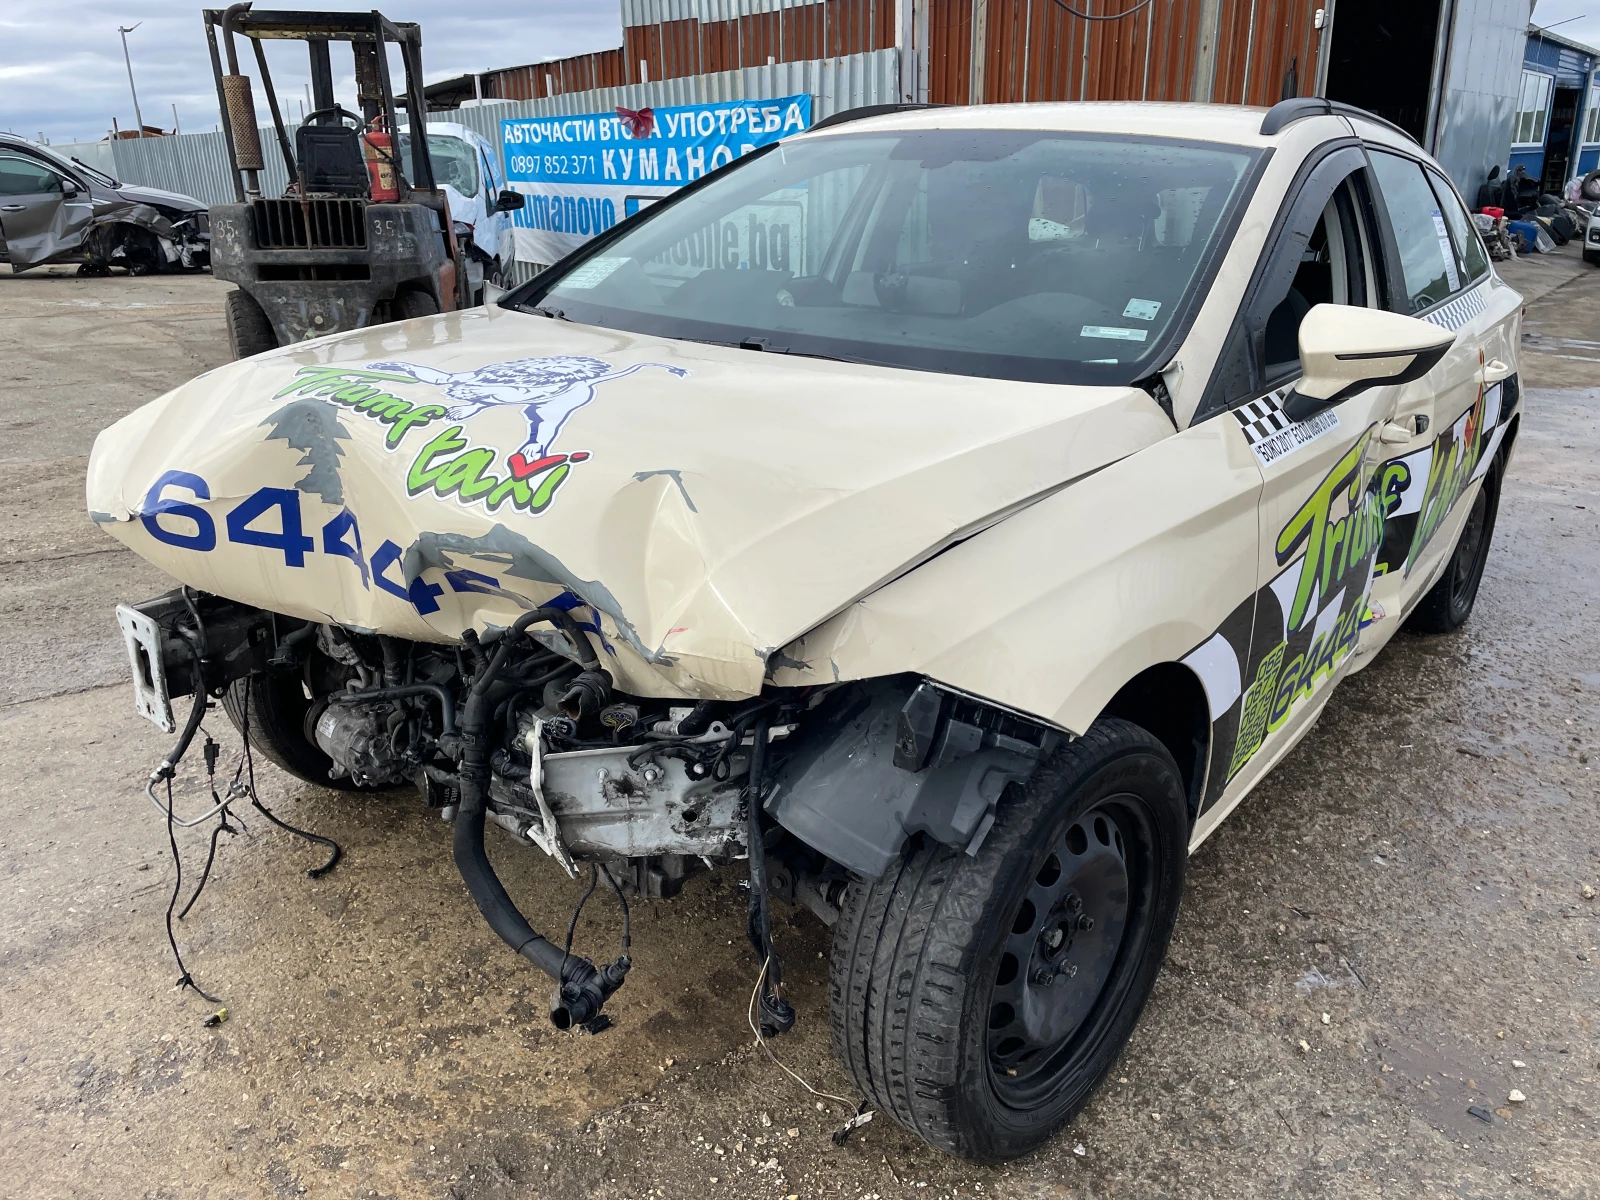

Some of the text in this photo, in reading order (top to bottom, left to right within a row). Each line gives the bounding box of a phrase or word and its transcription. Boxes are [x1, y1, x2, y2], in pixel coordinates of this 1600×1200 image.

[504, 102, 805, 144] АВТОЧАСТИ ВТОА УПОТРЕБА
[511, 155, 541, 174] 0897
[544, 155, 569, 174] 852
[571, 155, 595, 175] 371
[271, 365, 448, 450] Triumf
[406, 425, 591, 515] taxi
